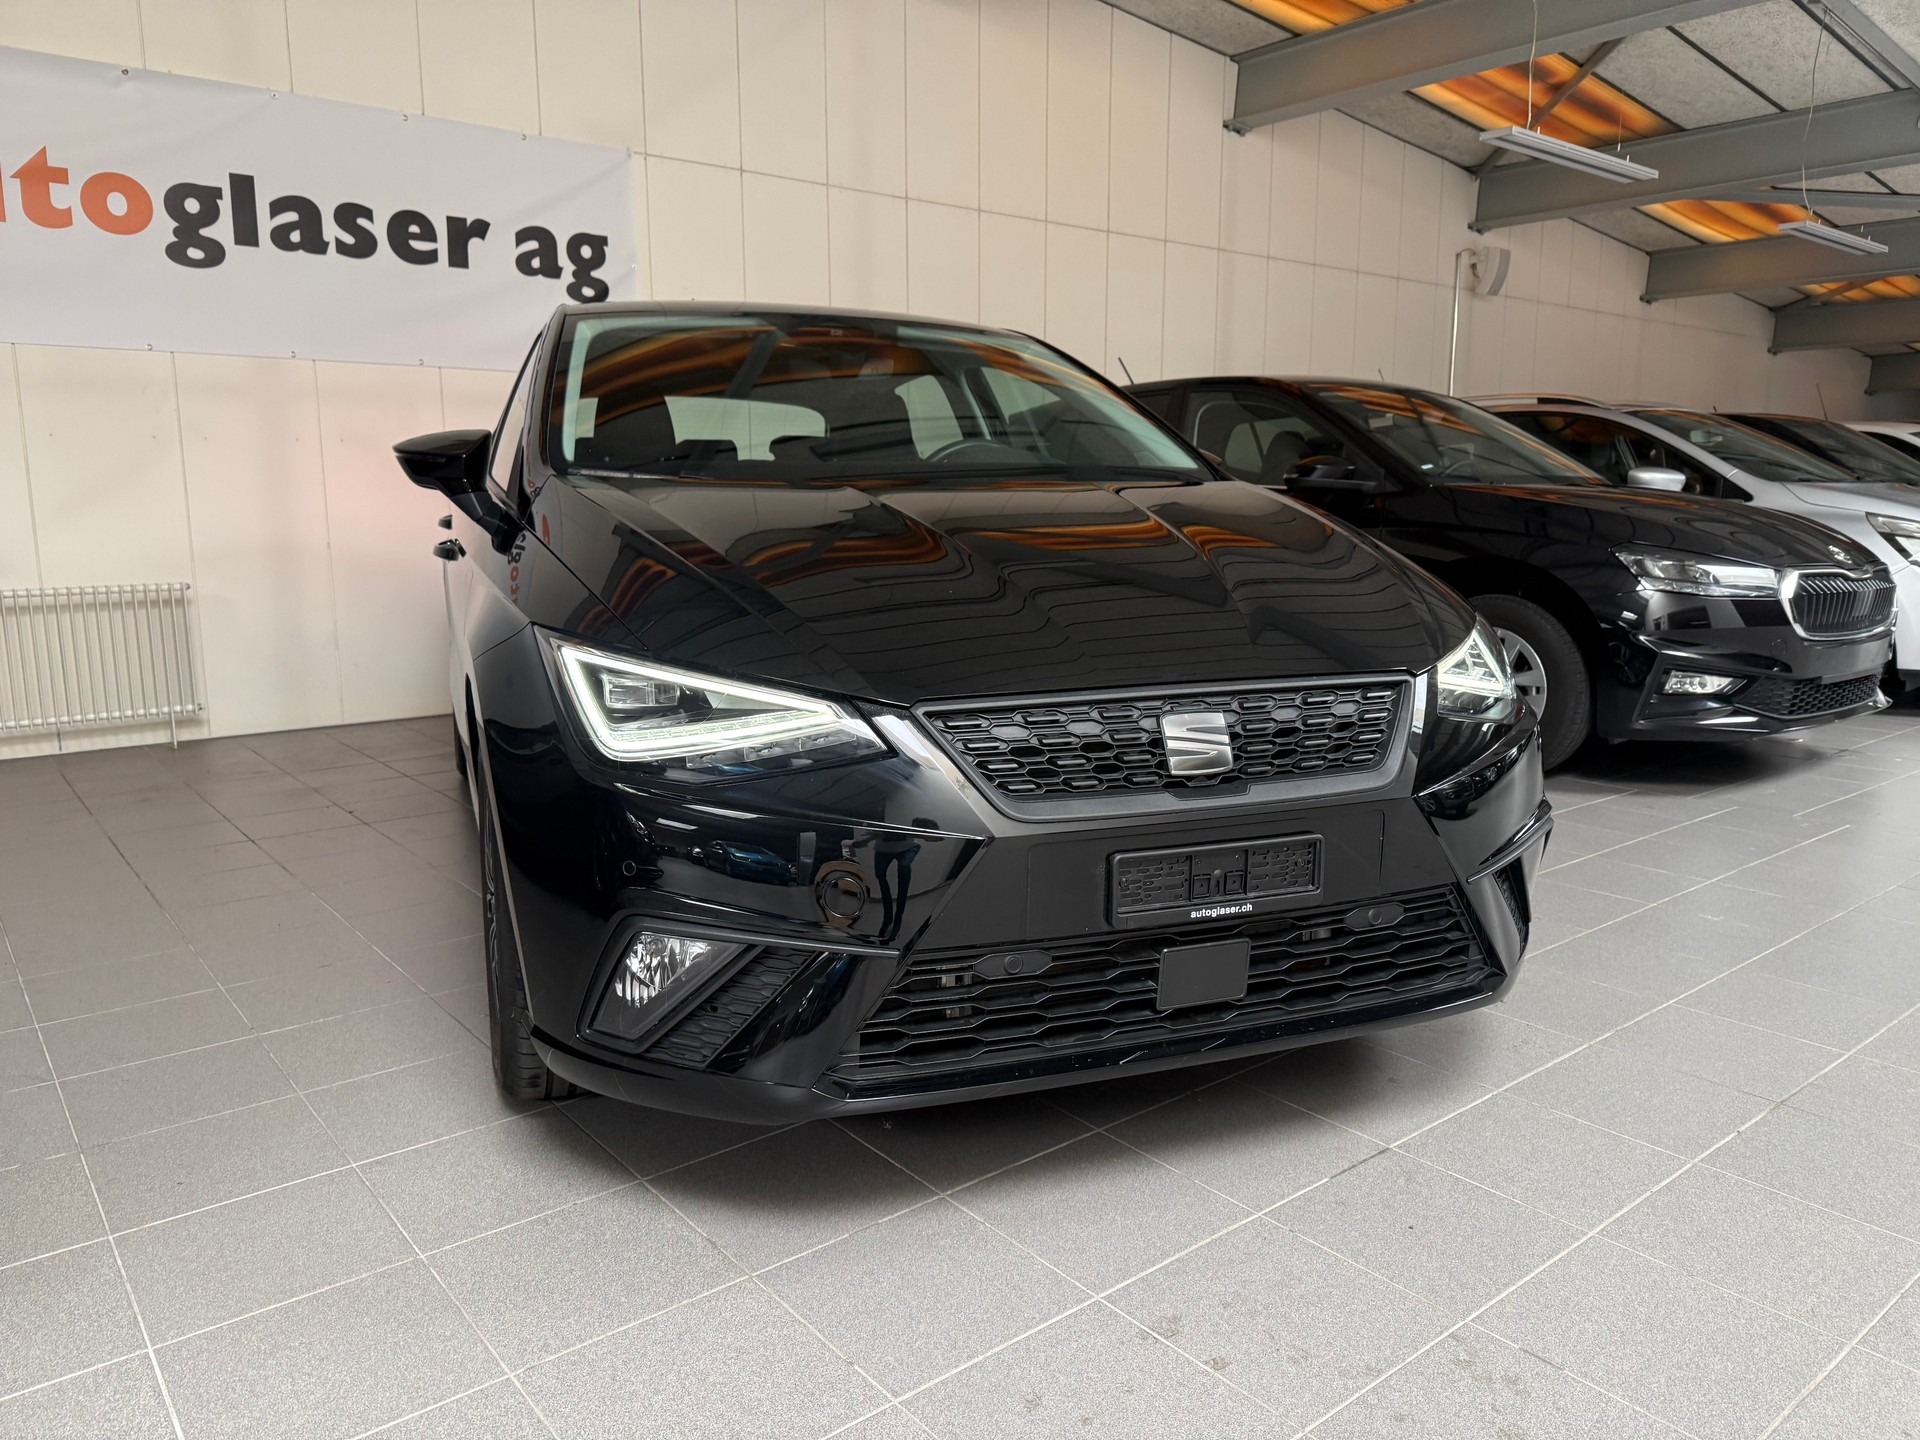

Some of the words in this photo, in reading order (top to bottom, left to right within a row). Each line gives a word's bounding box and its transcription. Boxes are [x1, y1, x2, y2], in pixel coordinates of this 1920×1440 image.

[0, 145, 490, 269] toglaser
[515, 225, 610, 303] ag
[1190, 902, 1253, 919] autoglaser.ch
